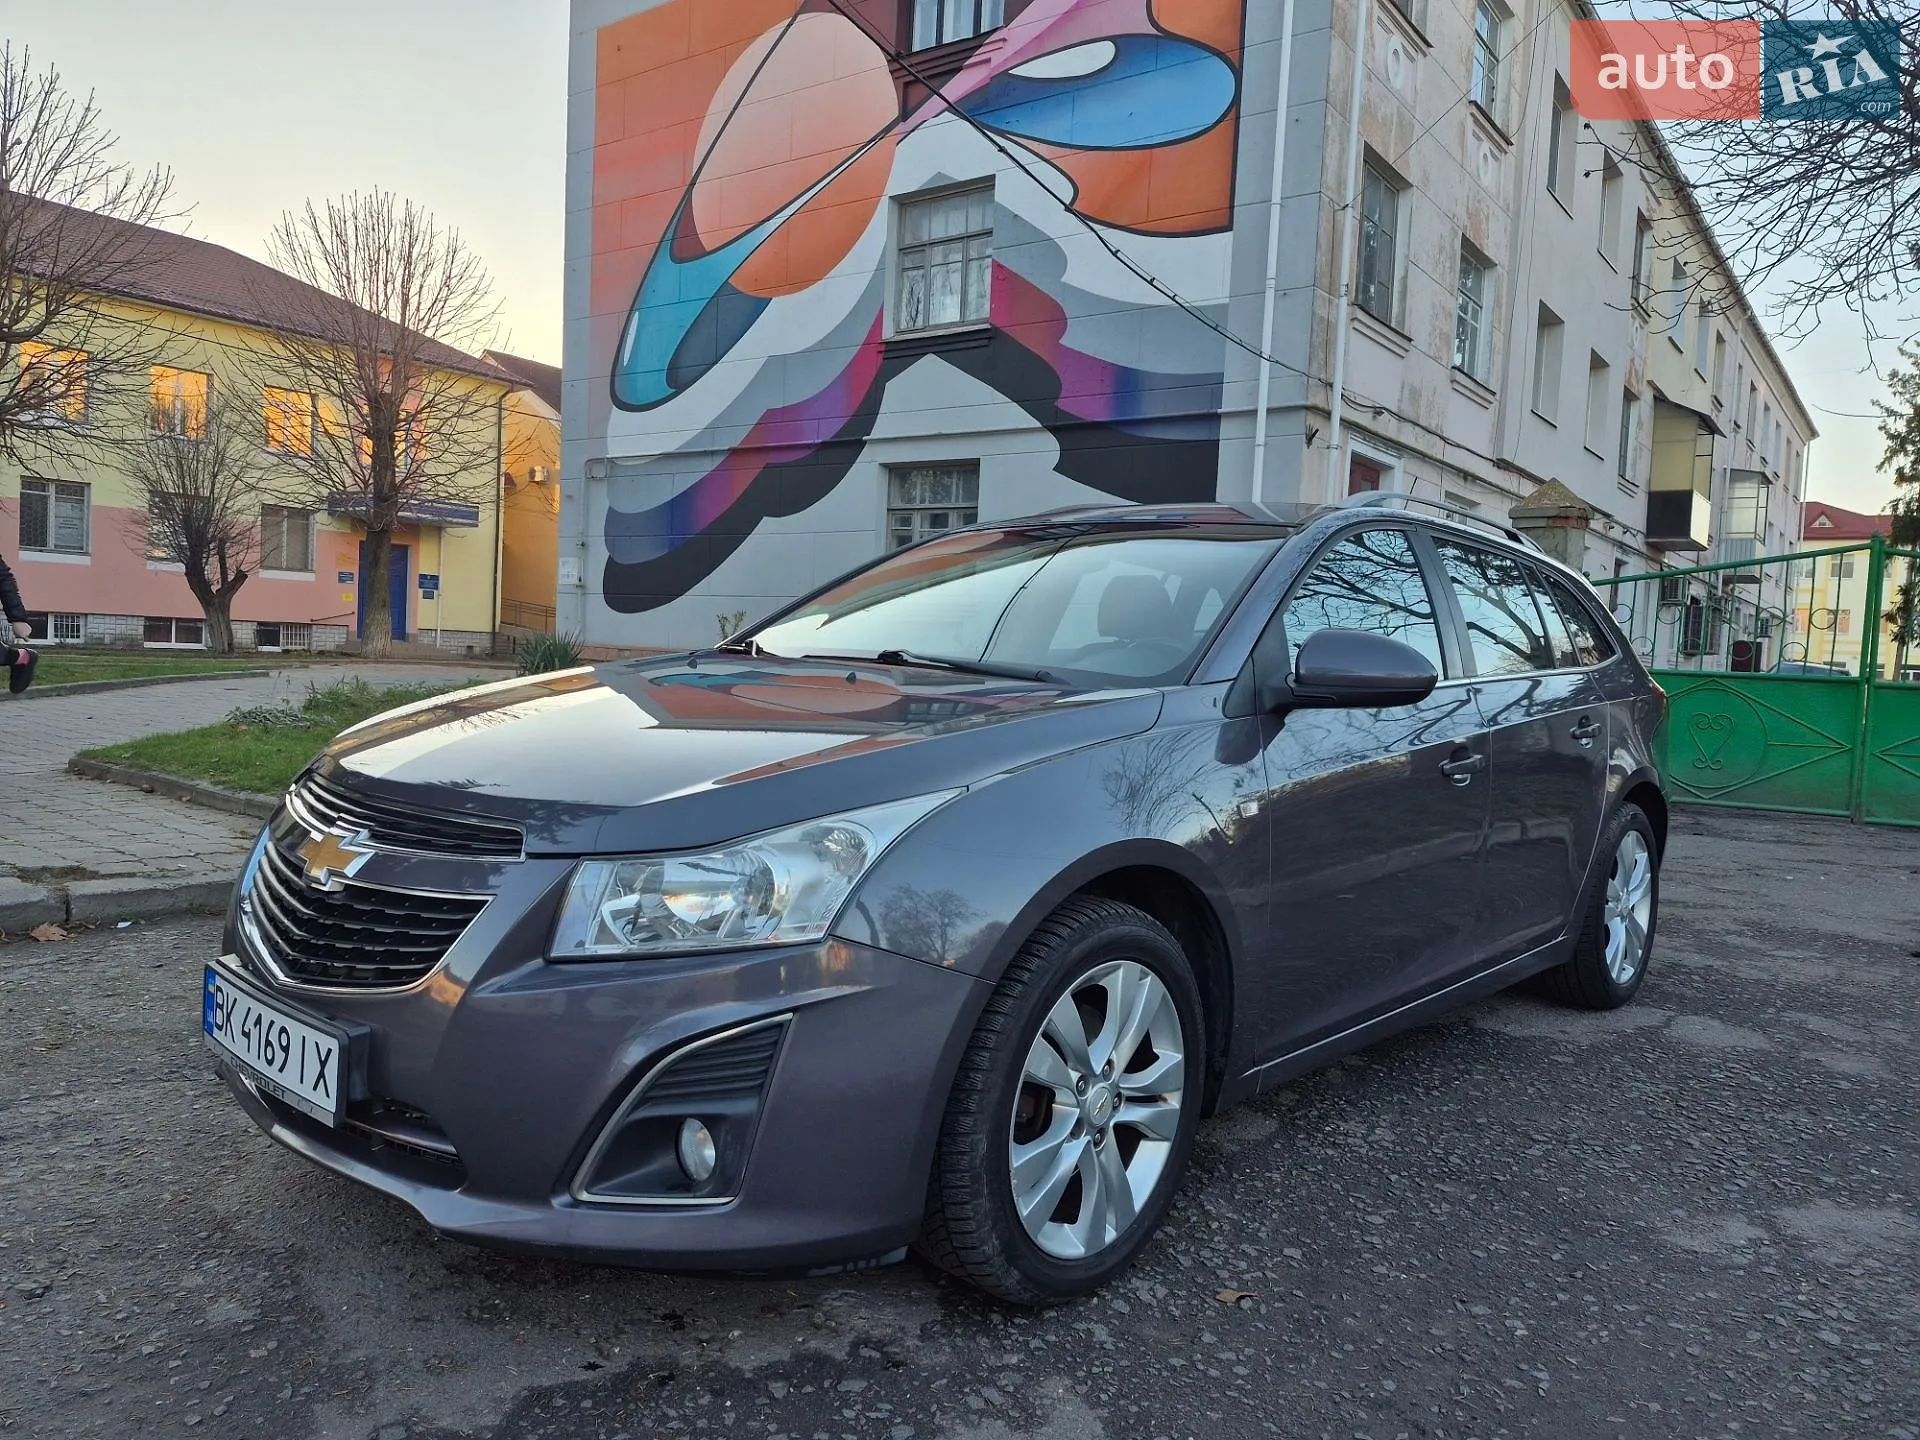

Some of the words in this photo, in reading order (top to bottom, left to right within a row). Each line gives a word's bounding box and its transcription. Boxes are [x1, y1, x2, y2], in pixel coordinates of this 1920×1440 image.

[215, 984, 237, 1044] BK
[241, 1006, 291, 1073] 4169
[300, 1035, 333, 1099] IX
[230, 1057, 286, 1099] CHEVROLET
